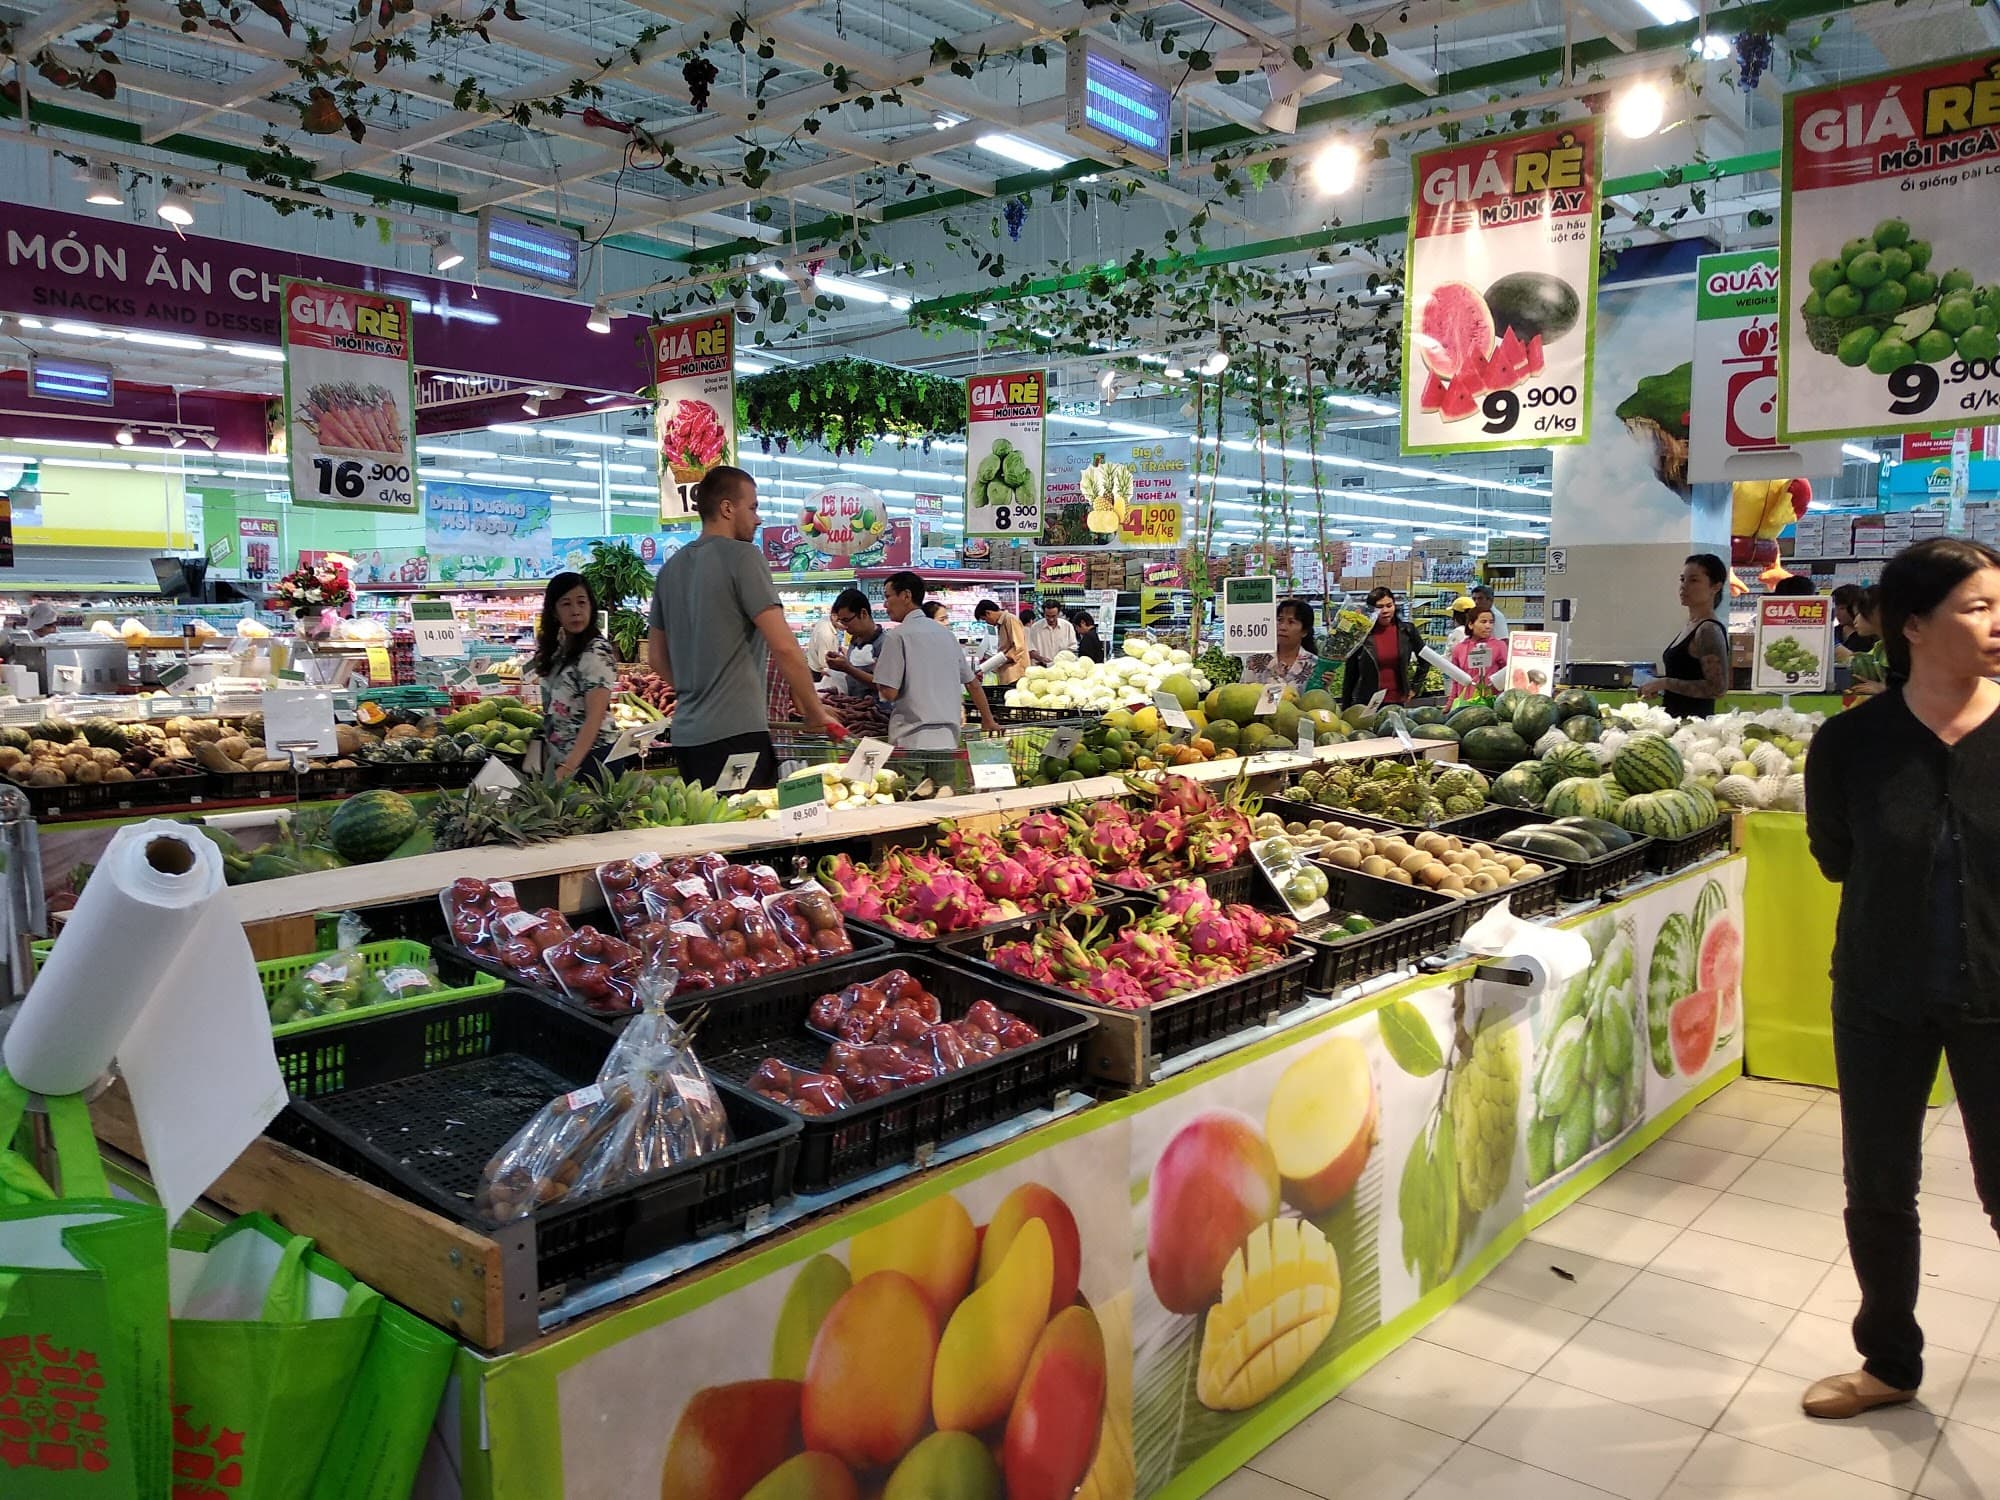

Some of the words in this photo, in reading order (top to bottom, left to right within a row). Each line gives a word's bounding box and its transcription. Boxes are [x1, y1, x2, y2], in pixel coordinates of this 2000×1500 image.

[1801, 86, 1915, 152] GIÁ
[1880, 141, 1932, 172] MỖI
[1939, 130, 2000, 162] NGÀ
[1423, 150, 1507, 206] GIÁ
[1515, 134, 1583, 194] RẺ
[1919, 174, 1957, 190] giống
[1962, 169, 1981, 181] Đài
[1482, 199, 1518, 225] MỖI
[1566, 219, 1586, 230] hấu
[1571, 231, 1586, 241] đỏ
[8, 230, 126, 282] MÓN
[145, 245, 212, 294] ĂN
[1710, 265, 1779, 293] QUẦY
[33, 286, 136, 317] SNACKS
[145, 303, 196, 325] AND
[205, 311, 280, 336] DESSE
[1736, 296, 1768, 307] WEIGH
[291, 296, 353, 331] GIÁ
[357, 304, 400, 341] RẺ
[335, 335, 361, 351] MỖI
[365, 338, 402, 356] NGÀY
[659, 328, 692, 362] GIÁ
[695, 321, 726, 356] RẺ
[681, 358, 698, 375] MỖI
[701, 357, 727, 372] NGÀY
[972, 379, 1006, 406] GIÁ
[1009, 376, 1038, 404] RẺ
[1888, 364, 1940, 415] 9
[995, 404, 1011, 418] MỖI
[1012, 403, 1039, 416] NGÀY
[1482, 390, 1520, 434] 9
[1522, 385, 1577, 408] .900
[1534, 414, 1576, 432] đ/kg
[1066, 455, 1091, 466] Group
[1132, 447, 1152, 459] Big
[1154, 445, 1164, 457] C
[313, 458, 365, 498] 16
[367, 464, 410, 483] .900
[1046, 483, 1076, 491] CHUNG
[379, 488, 412, 505] đ/kg
[240, 520, 260, 531] GIÁ
[996, 506, 1011, 530] 8
[1013, 505, 1038, 517] .900
[1122, 509, 1145, 536] 4
[1765, 602, 1797, 617] GIÁ
[1799, 602, 1824, 617] RẺ
[423, 630, 455, 641] 14.100
[1230, 623, 1268, 638] 66.500
[1785, 671, 1800, 684] 9
